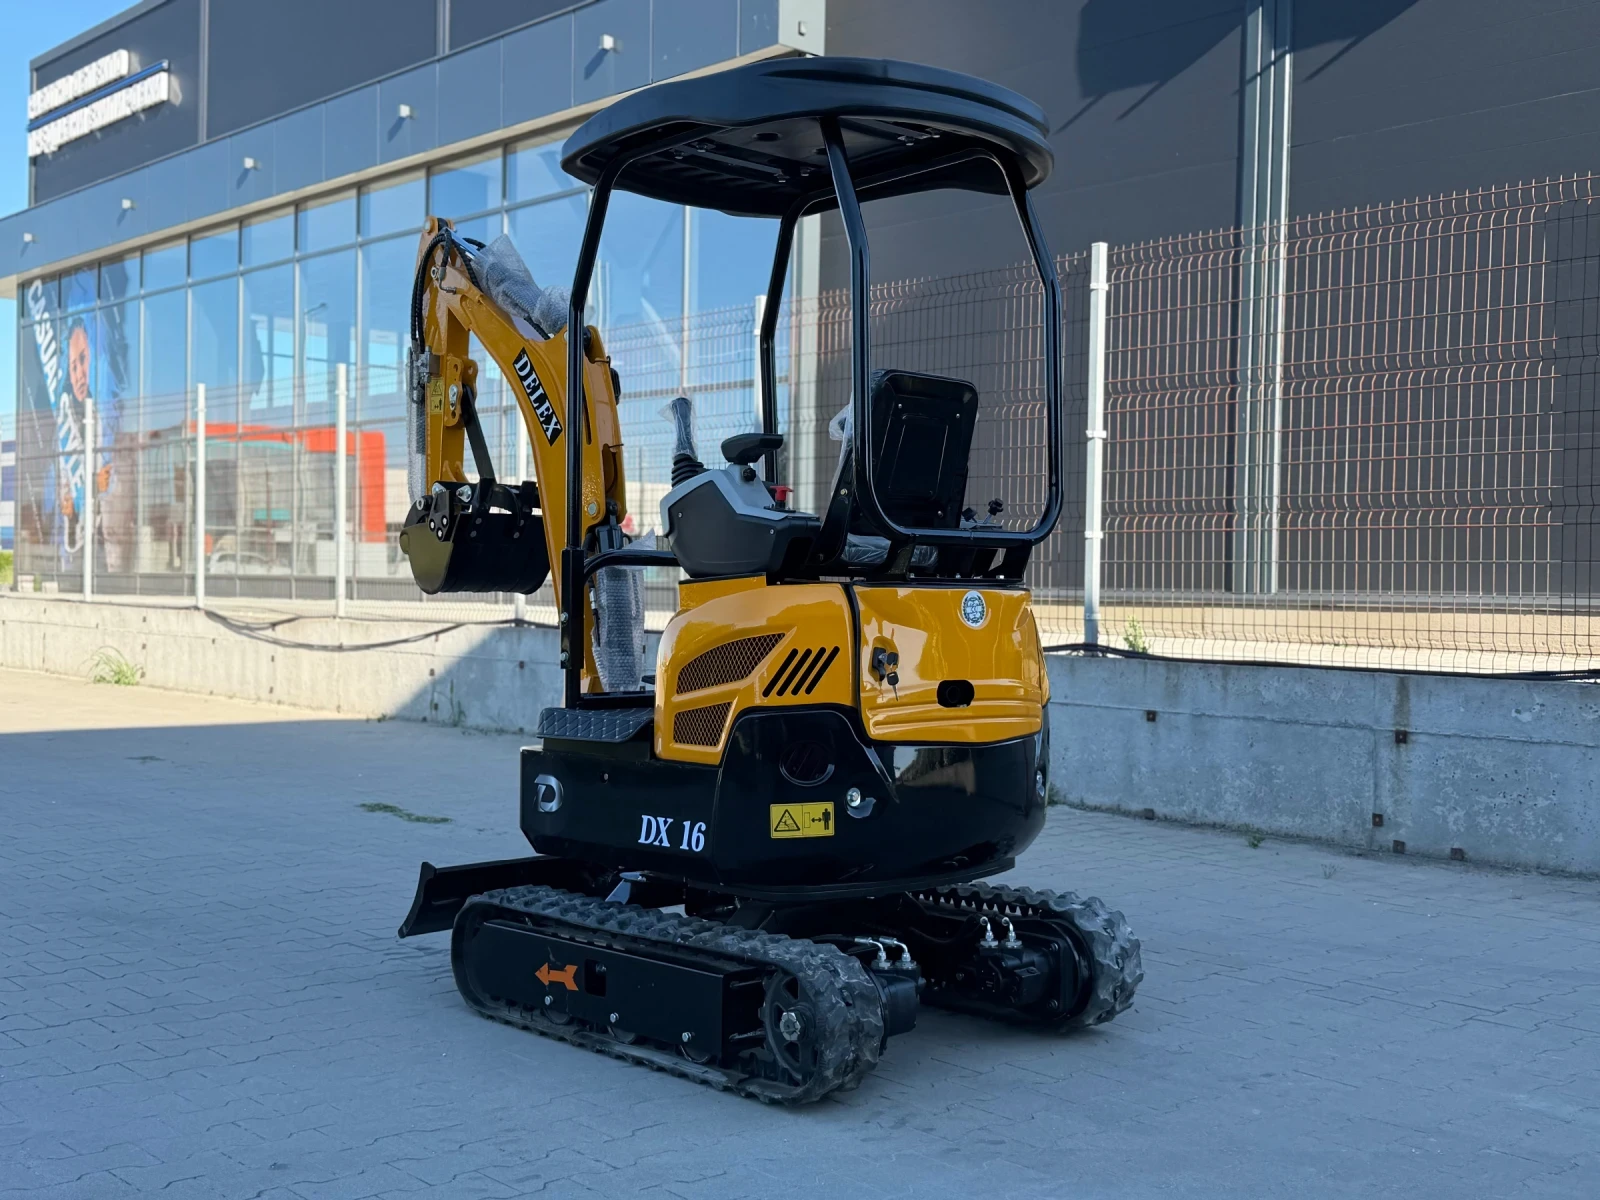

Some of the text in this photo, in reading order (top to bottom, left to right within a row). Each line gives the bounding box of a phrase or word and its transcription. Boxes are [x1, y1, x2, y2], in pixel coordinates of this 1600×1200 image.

[28, 279, 62, 403] CASUAL
[58, 392, 86, 498] STYLE
[514, 353, 562, 441] DELEX
[637, 815, 707, 852] DX 16
